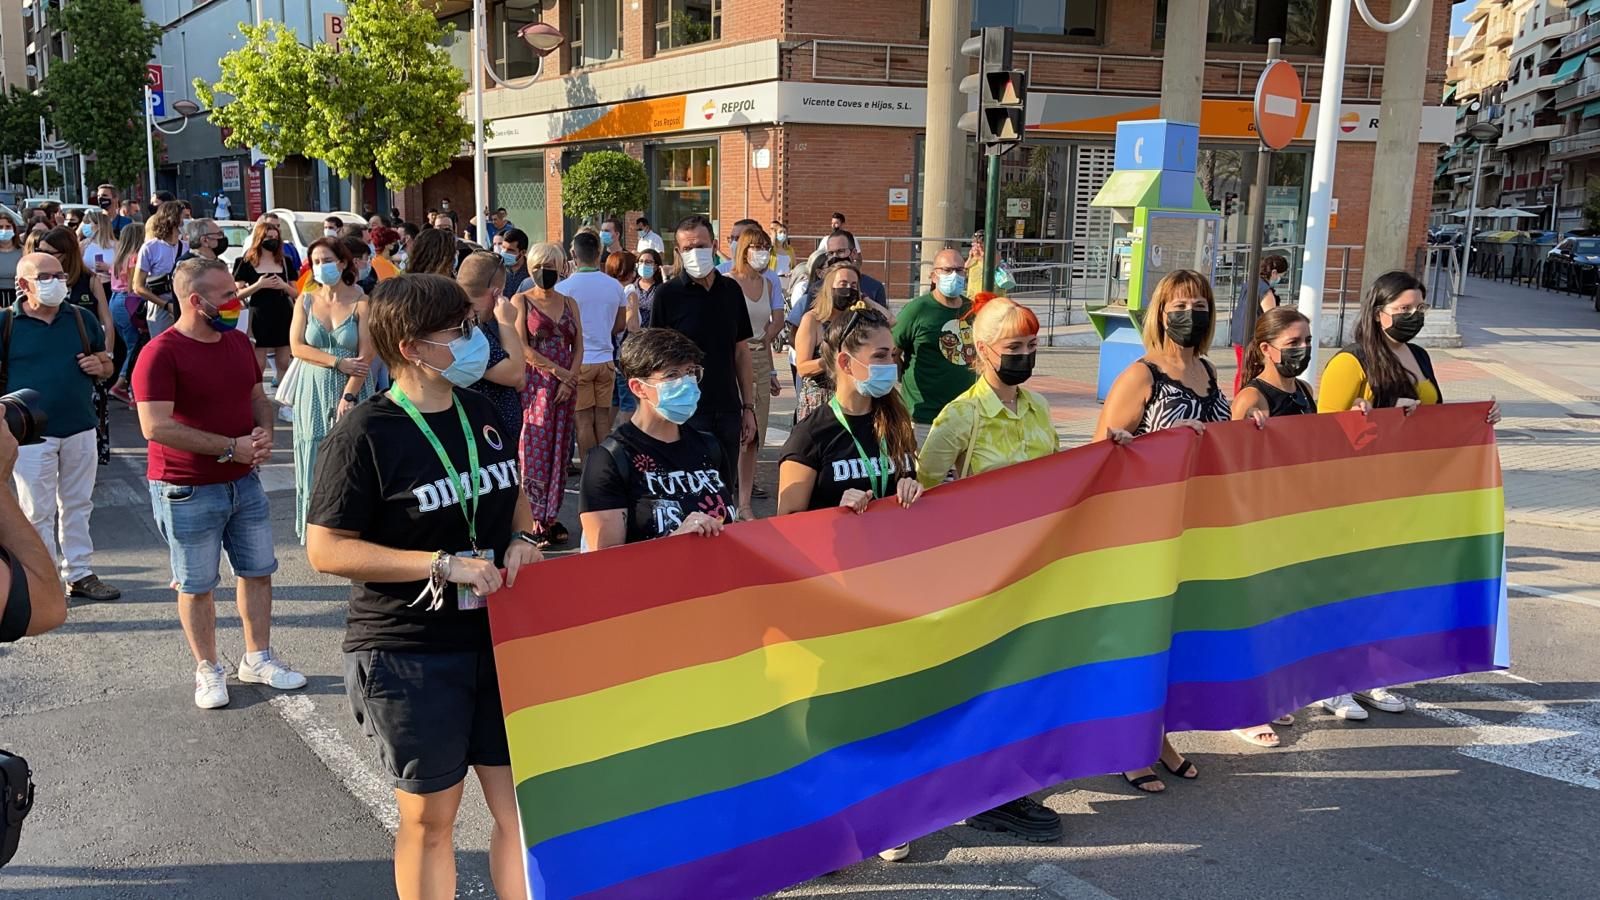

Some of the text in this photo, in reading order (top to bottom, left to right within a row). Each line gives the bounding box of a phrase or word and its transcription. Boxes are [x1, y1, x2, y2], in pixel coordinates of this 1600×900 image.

[720, 99, 756, 114] REPSOL
[802, 97, 836, 107] Vicente
[836, 99, 862, 108] Coves
[871, 101, 895, 111] Hijos,
[896, 102, 912, 110] S.L.
[656, 506, 684, 533] IS
